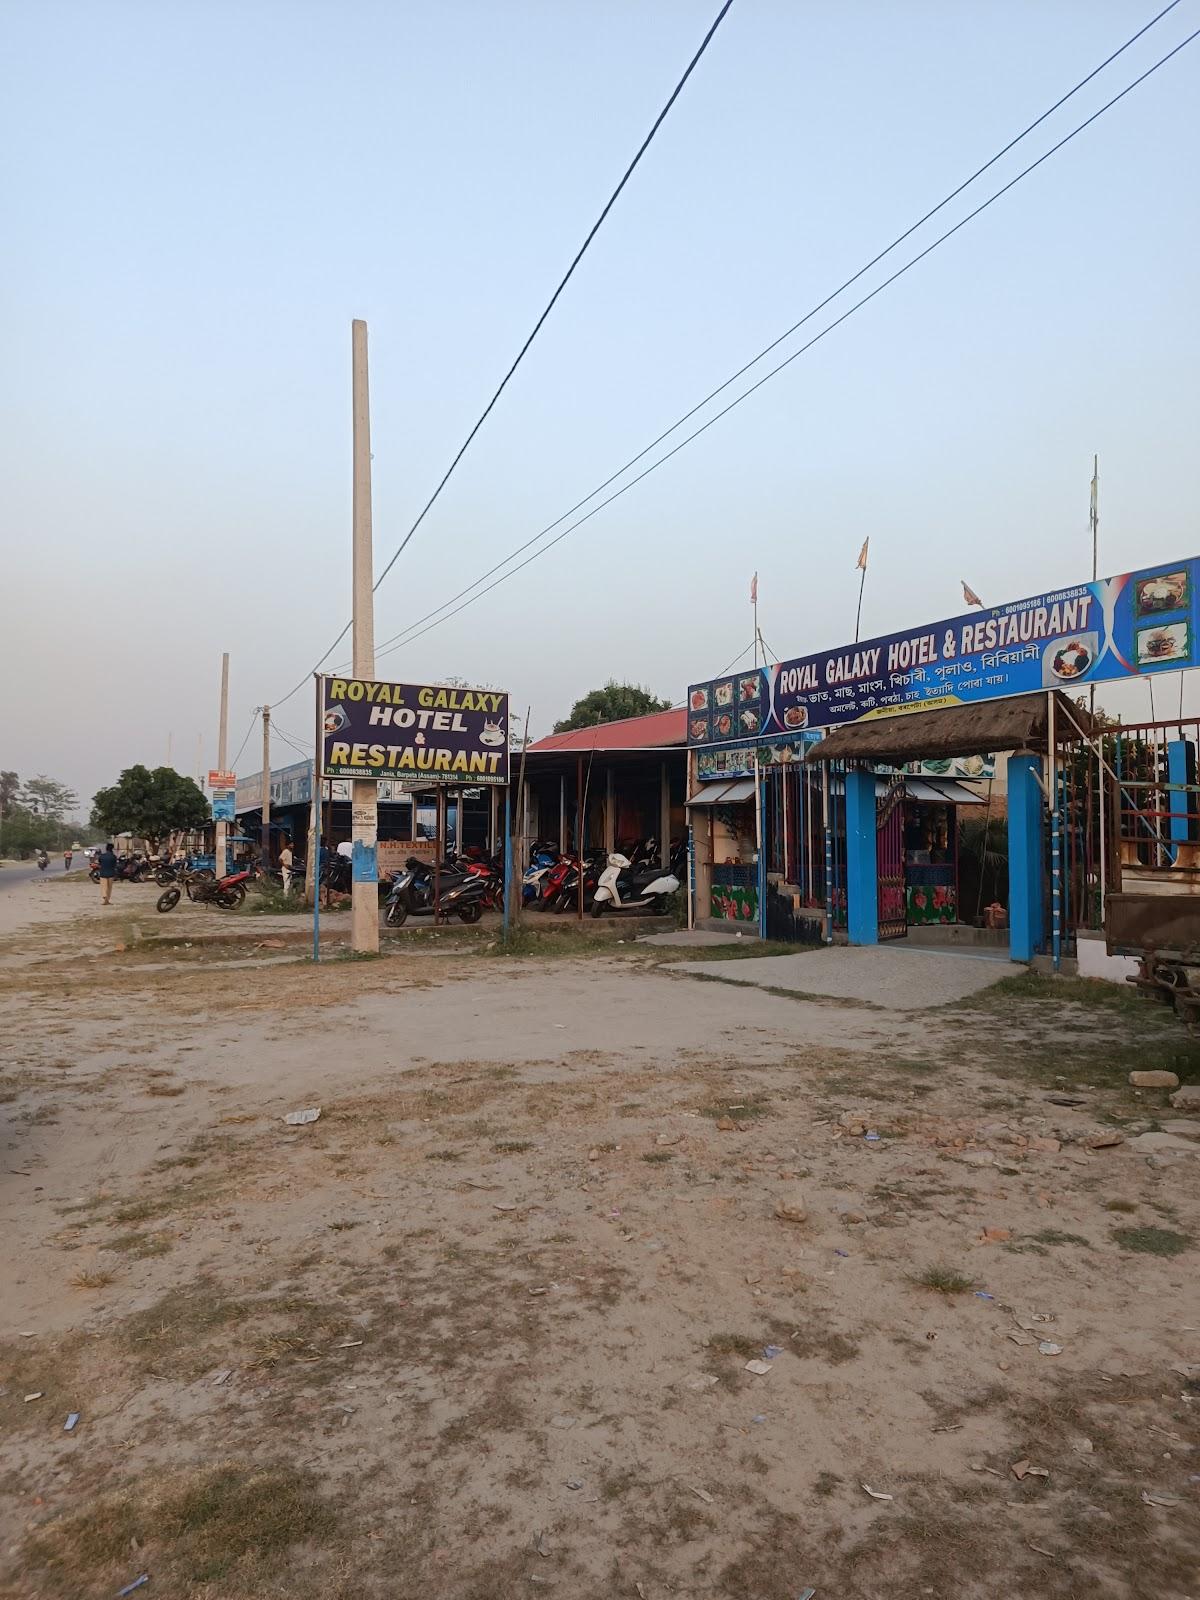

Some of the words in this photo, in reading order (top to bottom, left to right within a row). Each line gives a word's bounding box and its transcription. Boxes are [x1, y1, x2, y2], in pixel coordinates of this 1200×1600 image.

[780, 663, 819, 694] ROYAL
[826, 648, 880, 684] GALAXY
[888, 634, 938, 671] HOTEL
[943, 629, 956, 658] &
[961, 595, 1092, 655] RESTAURANT
[330, 680, 405, 704] ROYAL
[418, 687, 503, 713] GALAXY
[368, 706, 468, 732] HOTEL
[414, 732, 426, 745] &
[330, 742, 503, 774] RESTAURANT
